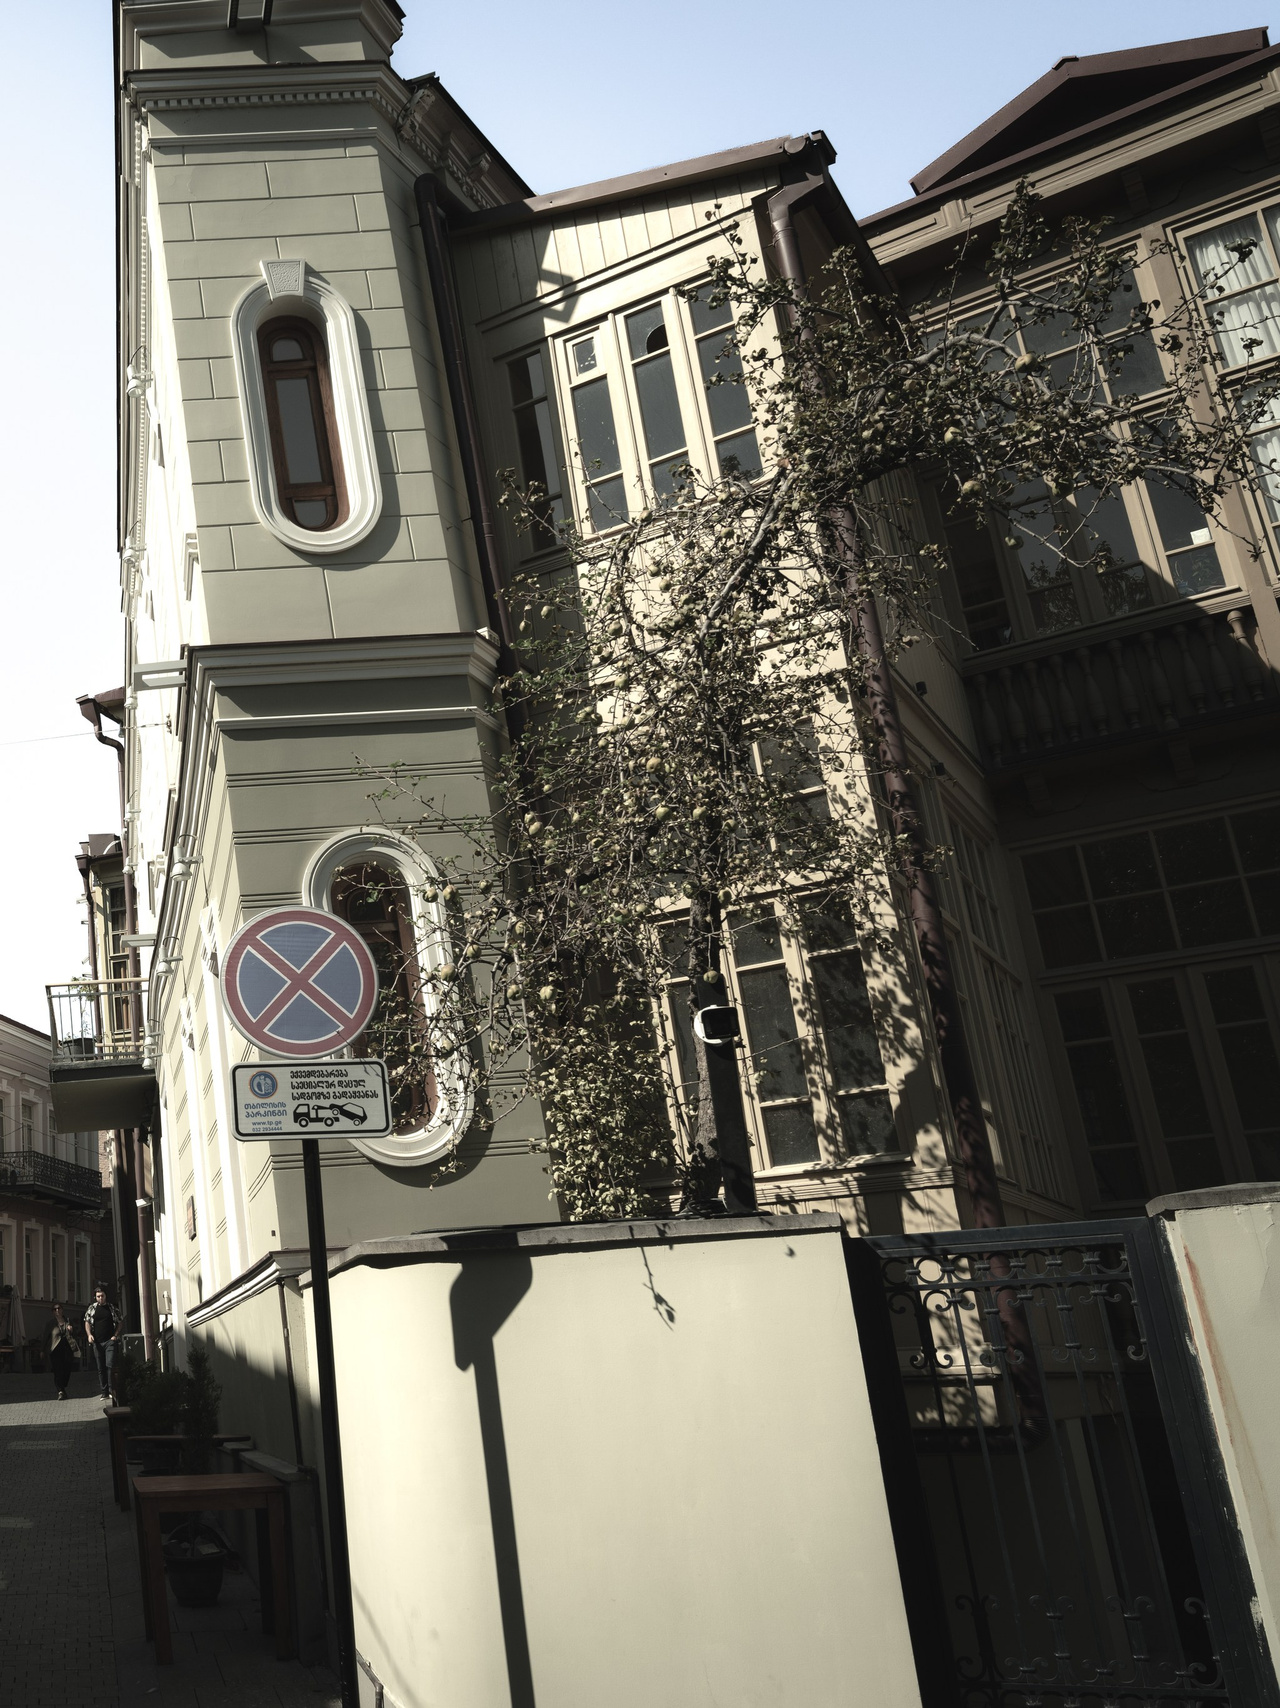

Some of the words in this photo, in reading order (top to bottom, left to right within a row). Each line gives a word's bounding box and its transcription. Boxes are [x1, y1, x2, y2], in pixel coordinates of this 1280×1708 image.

[289, 1069, 349, 1079] ექვემდებარება
[290, 1081, 337, 1091] სპეციალურ
[337, 1079, 366, 1089] დაცულ
[291, 1092, 331, 1101] სადგომზე
[244, 1101, 287, 1110] თბილისის
[245, 1109, 288, 1119] პარკინგი
